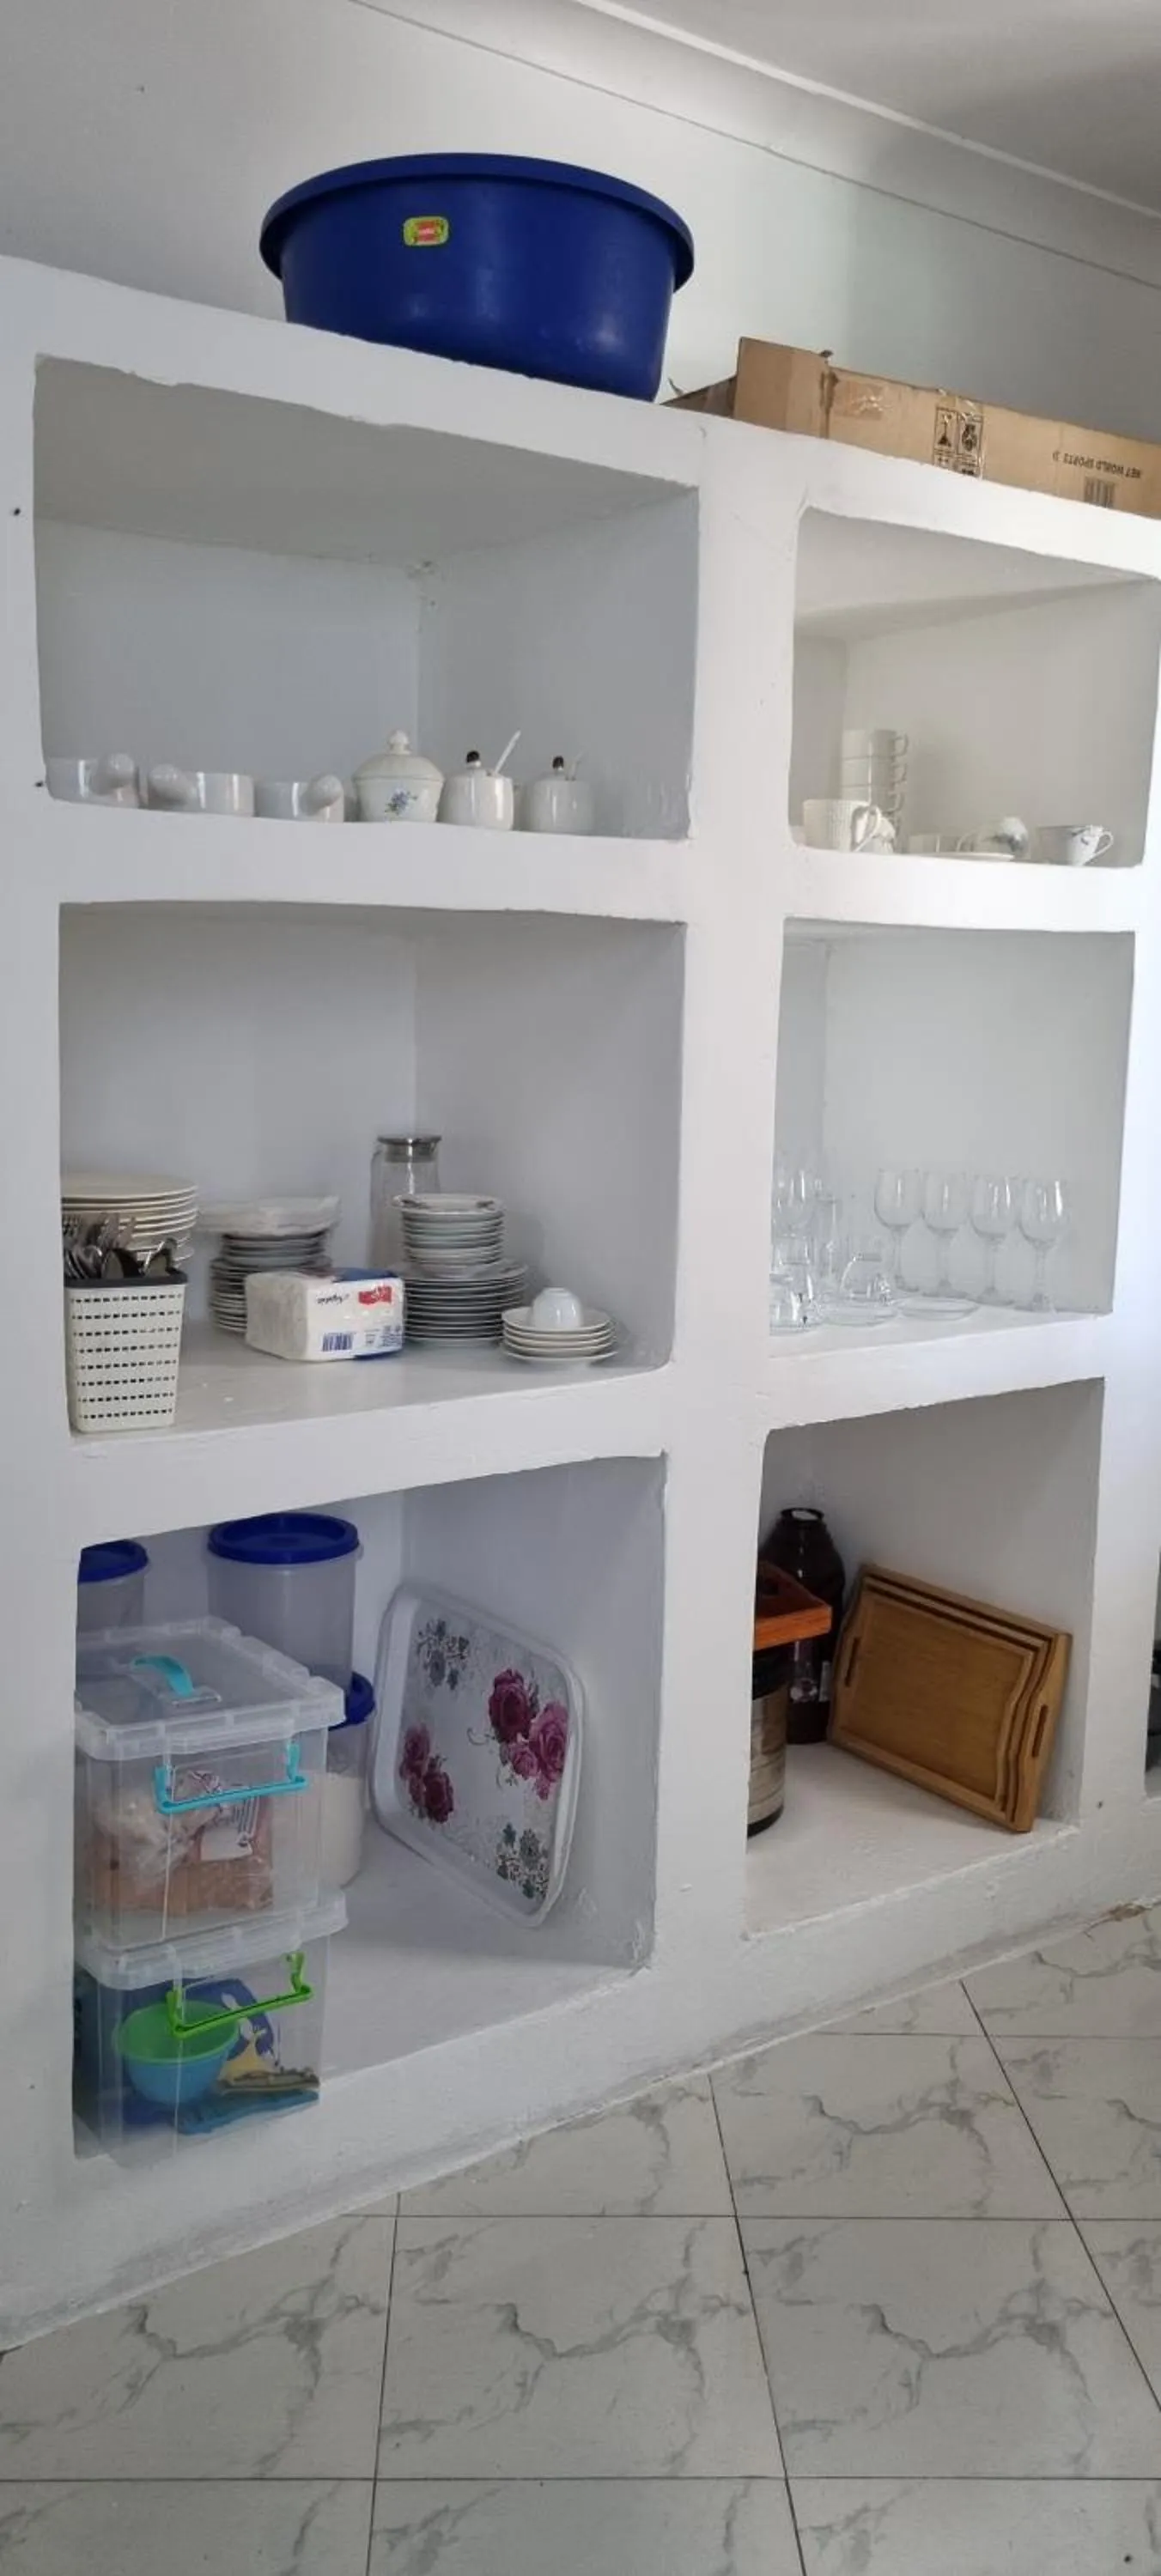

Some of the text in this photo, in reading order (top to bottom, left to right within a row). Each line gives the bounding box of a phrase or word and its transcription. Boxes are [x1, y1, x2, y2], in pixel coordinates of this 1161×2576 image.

[1063, 453, 1094, 470] SPORTS
[1096, 460, 1123, 475] WORLD
[1125, 466, 1141, 478] NET
